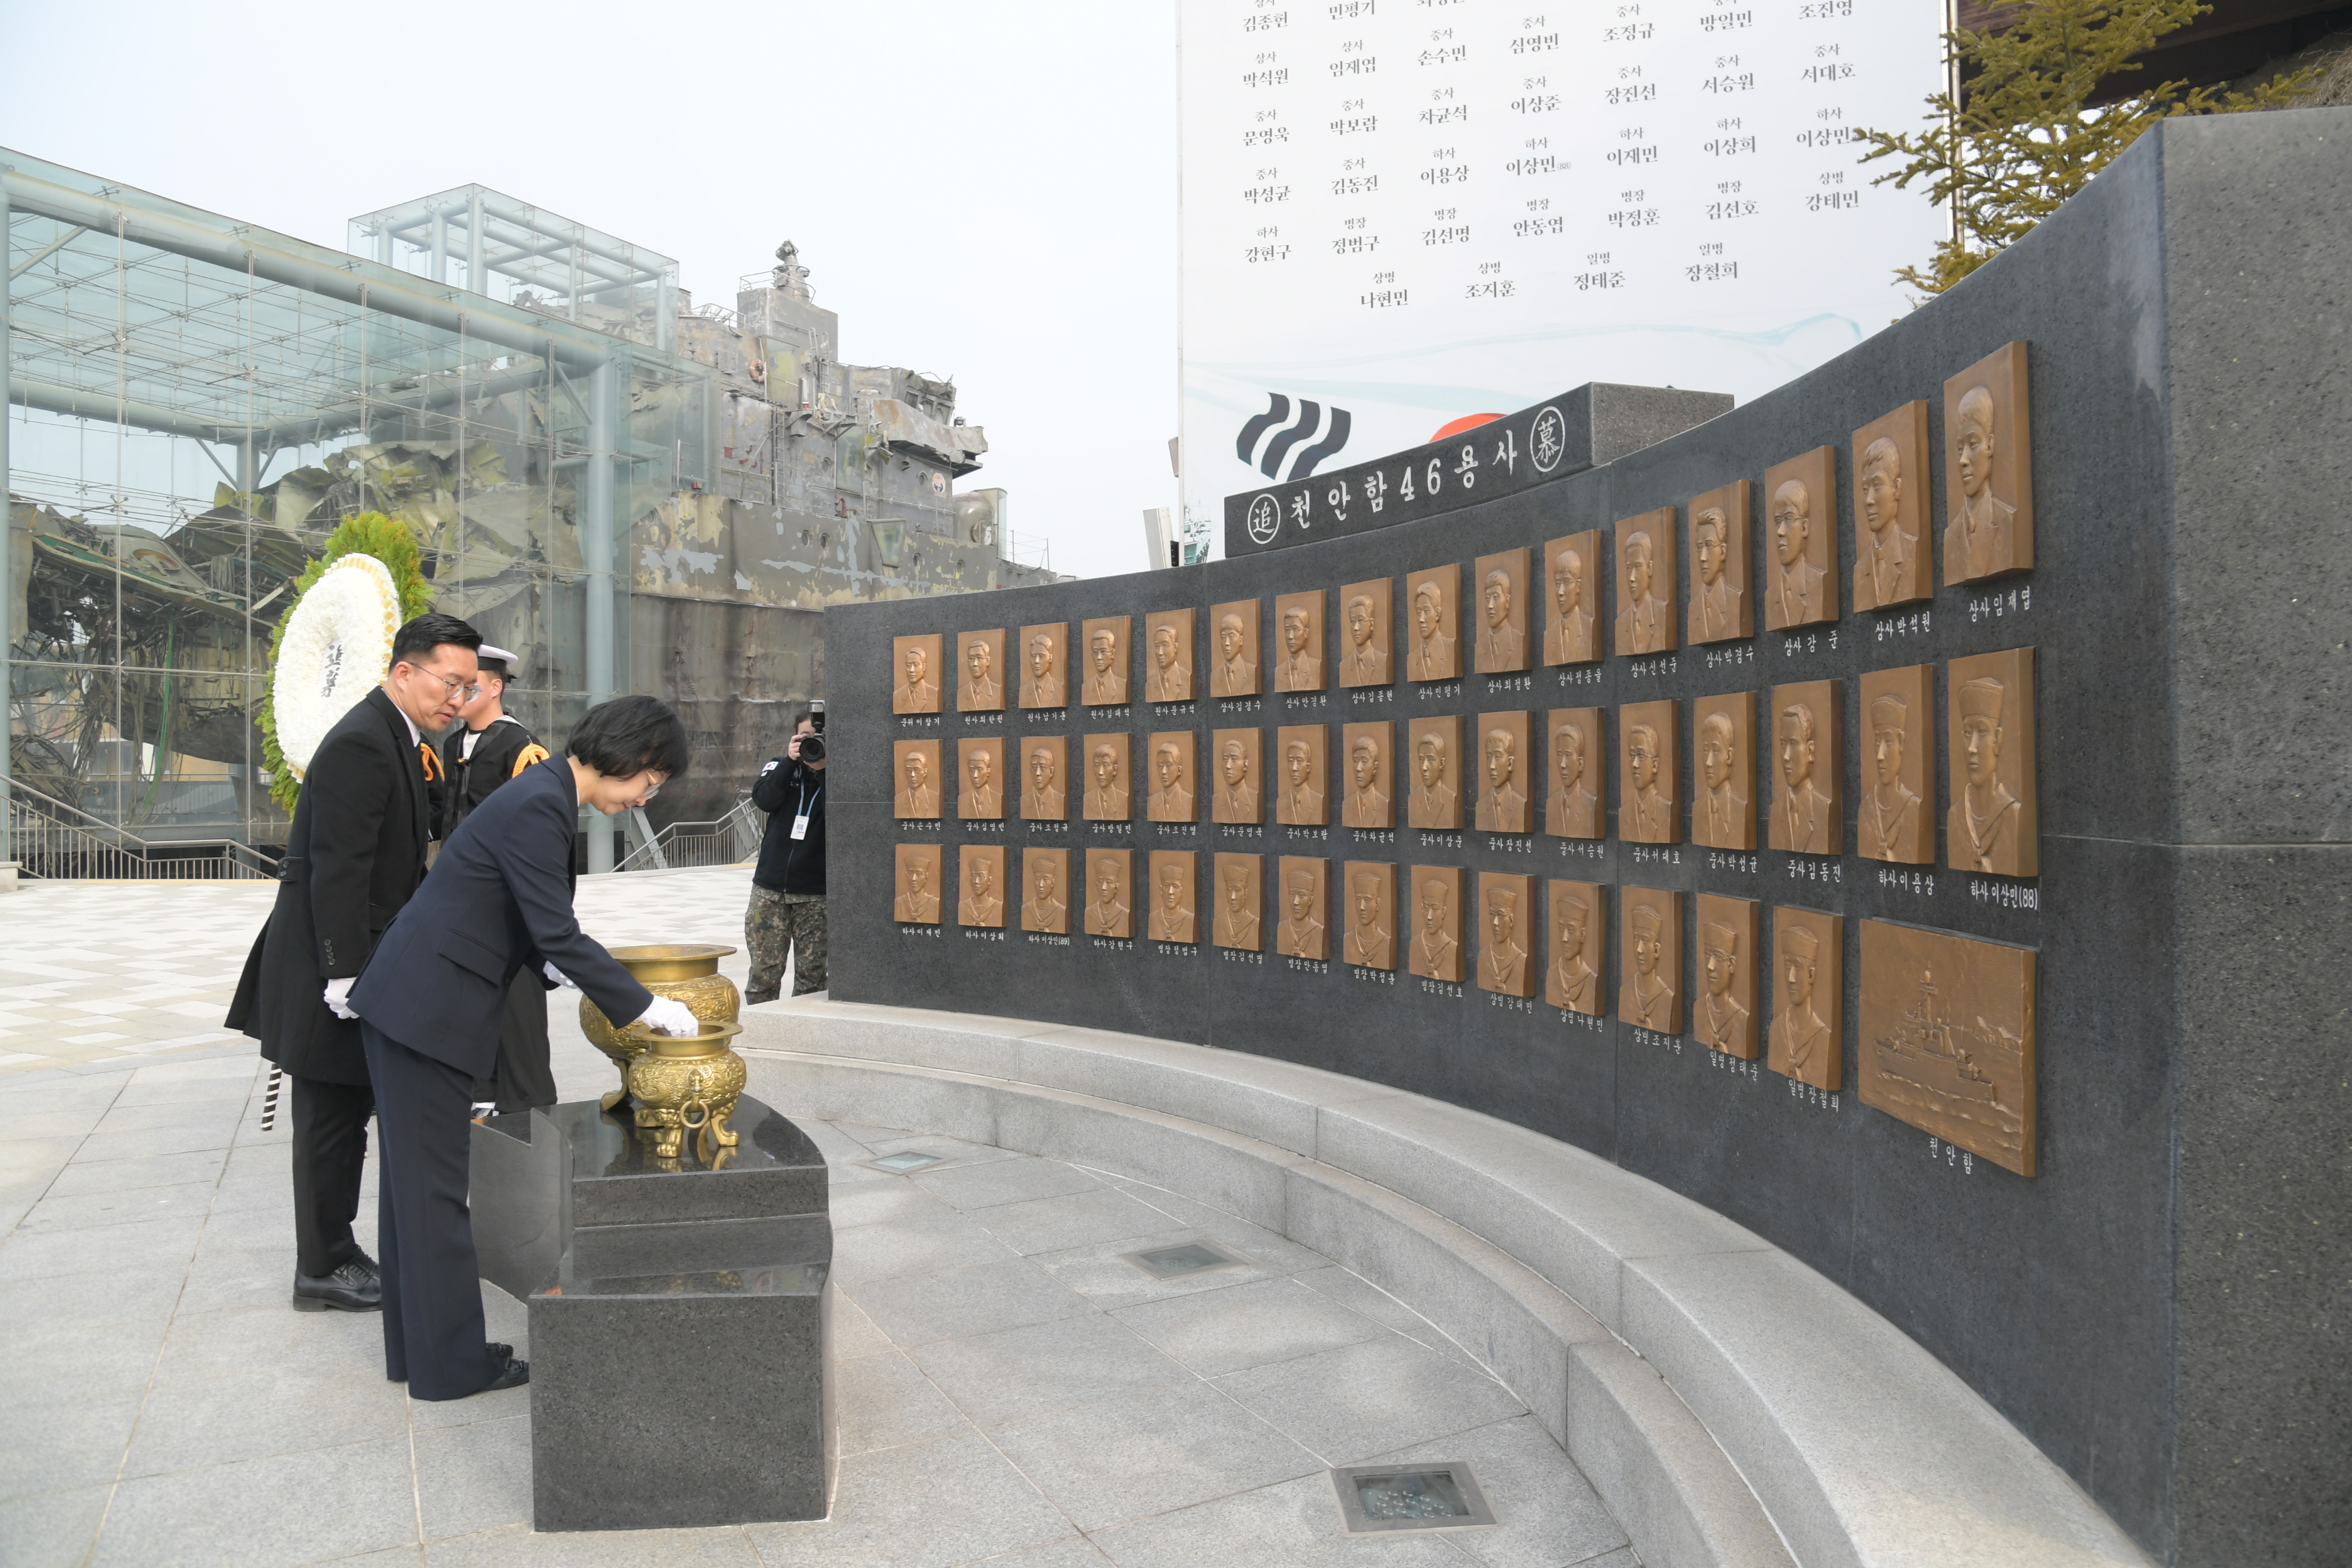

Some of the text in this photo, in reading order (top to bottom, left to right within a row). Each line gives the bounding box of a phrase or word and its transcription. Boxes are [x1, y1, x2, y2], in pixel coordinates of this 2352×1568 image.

[1329, 0, 1375, 20] 민평기
[1618, 3, 1641, 17] 중사
[1799, 0, 1852, 20] 조진영
[1243, 11, 1288, 32] 김종헌
[1523, 15, 1545, 29] 중사
[1700, 10, 1752, 32] 방일민
[1432, 27, 1454, 41] 중사
[1603, 23, 1655, 42] 조정규
[1342, 39, 1364, 53] 상사
[1510, 33, 1559, 55] 심영빈
[1816, 43, 1840, 57] 중사
[1255, 51, 1277, 64] 상사
[1418, 44, 1466, 66] 손수민
[1714, 54, 1740, 69] 중사
[1329, 56, 1375, 77] 임재엽
[1619, 65, 1642, 79] 중사
[1802, 63, 1856, 83] 서대호
[1243, 68, 1289, 88] 박석원
[1524, 75, 1547, 90] 중사
[1702, 73, 1754, 93] 서승원
[1432, 87, 1454, 101] 중사
[1605, 83, 1656, 105] 장진선
[1341, 98, 1365, 112] 중사
[1511, 94, 1561, 114] 이상준
[1255, 109, 1277, 122] 중사
[1419, 104, 1467, 125] 차균석
[1816, 106, 1842, 121] 하사
[1330, 115, 1378, 136] 박보람
[1717, 117, 1742, 131] 하사
[1242, 127, 1290, 146] 문영욱
[1619, 127, 1644, 140] 하사
[1525, 137, 1549, 150] 하사
[1704, 135, 1756, 157] 이상희
[1432, 147, 1456, 161] 하사
[1607, 145, 1658, 166] 이재민
[1342, 157, 1366, 171] 중사
[1255, 167, 1278, 181] 중사
[1420, 164, 1470, 185] 이용상
[1819, 171, 1843, 185] 상병
[1331, 175, 1378, 195] 김동진
[1717, 180, 1742, 194] 병장
[1244, 185, 1291, 204] 박성균
[1621, 189, 1645, 203] 병장
[1805, 190, 1859, 212] 강태민
[1526, 198, 1550, 212] 병장
[1706, 200, 1759, 220] 김선호
[1434, 207, 1457, 221] 병장
[1608, 208, 1660, 228] 박정훈
[1344, 216, 1367, 230] 병장
[1513, 216, 1563, 237] 안동엽
[1257, 226, 1279, 239] 하사
[1422, 225, 1469, 246] 김선명
[1332, 235, 1380, 255] 정범구
[1699, 242, 1723, 256] 일병
[1245, 244, 1291, 263] 강현구
[1587, 251, 1610, 265] 일병
[1478, 261, 1500, 275] 상병
[1686, 261, 1738, 282] 장철희
[1373, 271, 1395, 284] 상병
[1574, 271, 1625, 291] 정태준
[1465, 280, 1516, 299] 조지훈
[1361, 289, 1408, 309] 나현민
[1968, 585, 2030, 622] 상사 임재엽
[1875, 611, 1930, 642] 상사 박석원
[1784, 636, 1802, 657] 상사
[1705, 645, 1754, 669] 상사 박경수
[1631, 657, 1677, 678] 상사 신선준
[1487, 676, 1531, 693] 상사 최정환
[1558, 671, 1574, 687] 상사
[1352, 692, 1366, 704] 상사
[1418, 684, 1460, 700] 상사 민평기
[1220, 700, 1261, 713] 상사 김경수
[1285, 697, 1300, 709] 상사
[900, 716, 939, 727] 준위 이창기
[1027, 712, 1041, 723] 원사
[901, 821, 941, 831] 중사 손수민
[966, 822, 1004, 832] 중사 심영빈
[1029, 822, 1068, 832] 중사 조정규
[1092, 823, 1131, 834] 중사 방일민
[1156, 825, 1196, 836] 중사 조진영
[1222, 826, 1263, 838] 중사 문영욱
[1287, 827, 1328, 840] 중사 박보람
[1353, 830, 1394, 844] 중사 차균석
[1420, 834, 1462, 848] 중사 이상준
[1489, 837, 1531, 853] 중사 장진선
[1560, 841, 1603, 859] 중사 서승원
[1633, 847, 1681, 864] 중사 서대호
[1709, 852, 1757, 874] 중사 박성균
[1787, 859, 1841, 883] 중사 김동진
[1878, 868, 1935, 896] 하사 이용상
[1970, 880, 2038, 911] 하사 이상민(88)
[1028, 934, 1040, 943] 하사
[1093, 938, 1133, 951] 하사 강현구
[1158, 944, 1197, 956] 병장 정범구
[1223, 950, 1263, 965] 병장 김선명
[1288, 958, 1328, 974] 병장 안동엽
[1353, 968, 1395, 985] 병장 박정훈
[1421, 979, 1463, 997] 병장 김선호
[1490, 993, 1532, 1014] 상병 강태민
[1560, 1009, 1603, 1032] 상병 나현민
[1634, 1028, 1681, 1055] 상병 조지훈
[1710, 1050, 1758, 1081] 일병 정태준
[1789, 1079, 1839, 1113] 일병 장철희
[1930, 1137, 1973, 1175] 천안함
